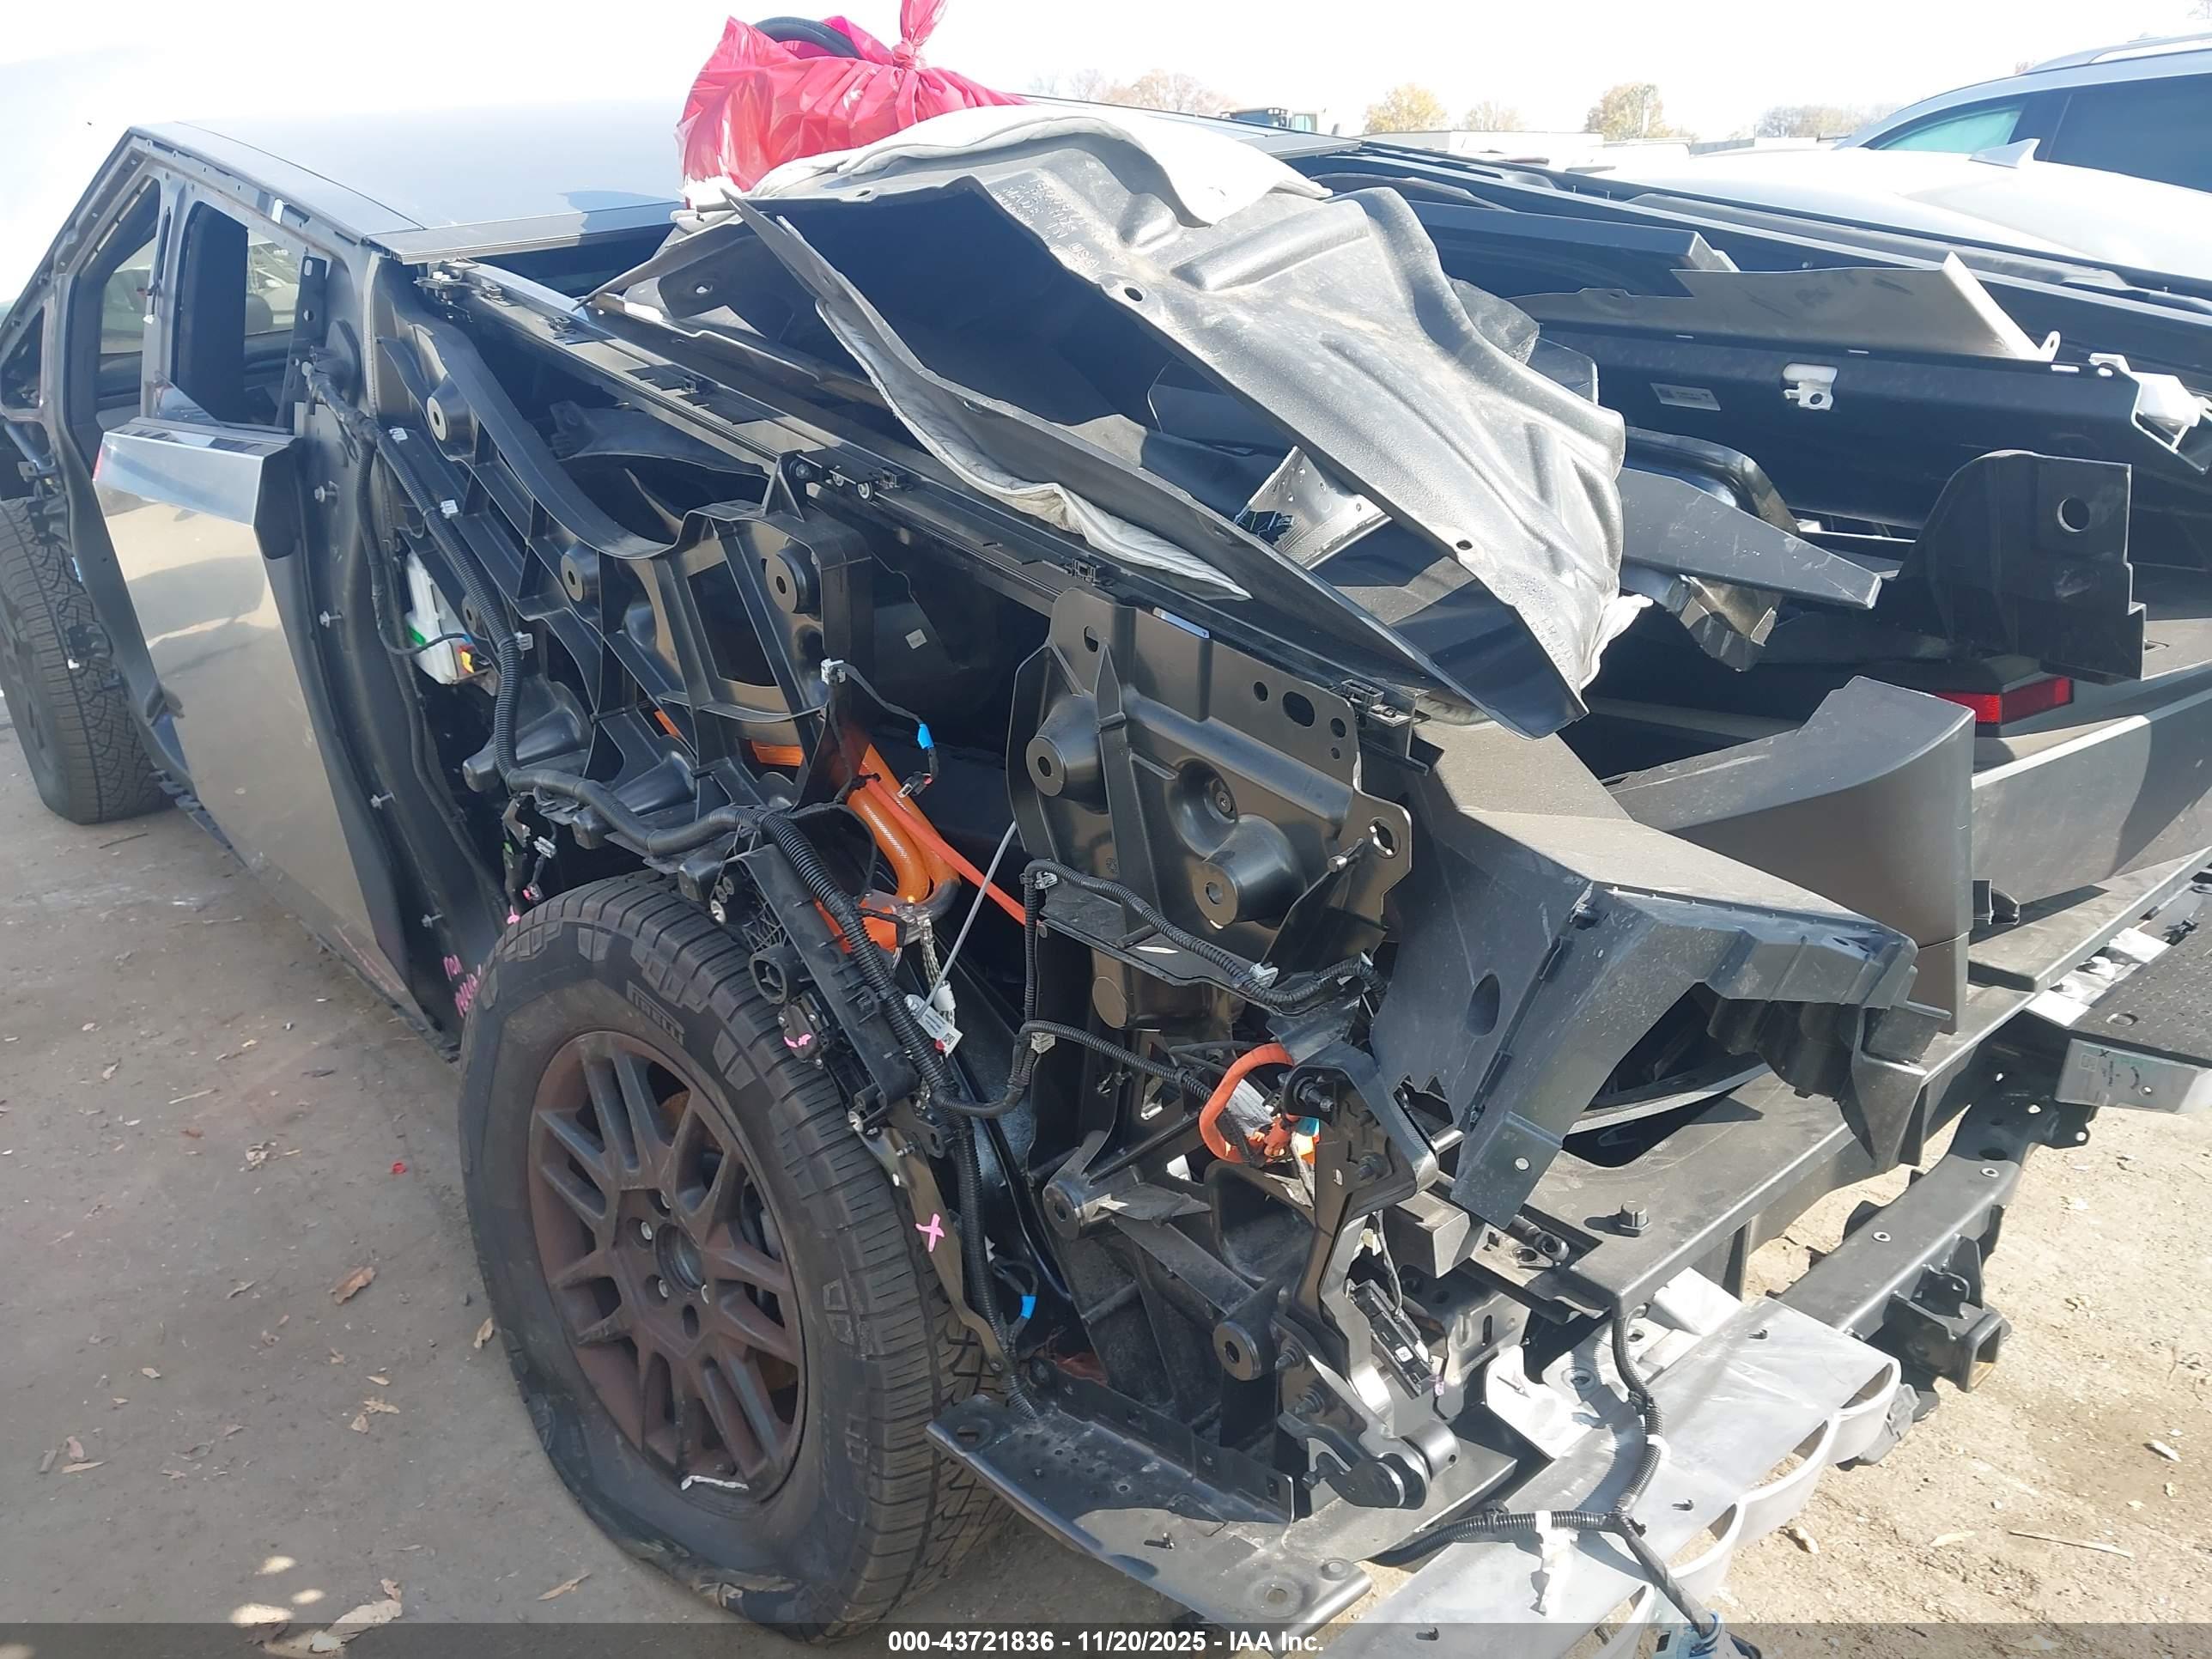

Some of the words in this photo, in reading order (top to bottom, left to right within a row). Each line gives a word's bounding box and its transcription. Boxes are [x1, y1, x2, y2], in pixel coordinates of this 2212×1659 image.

[1003, 186, 1044, 216] MADE
[1045, 222, 1069, 240] IN
[1069, 242, 1100, 269] USA
[626, 981, 684, 1046] PIRELLI
